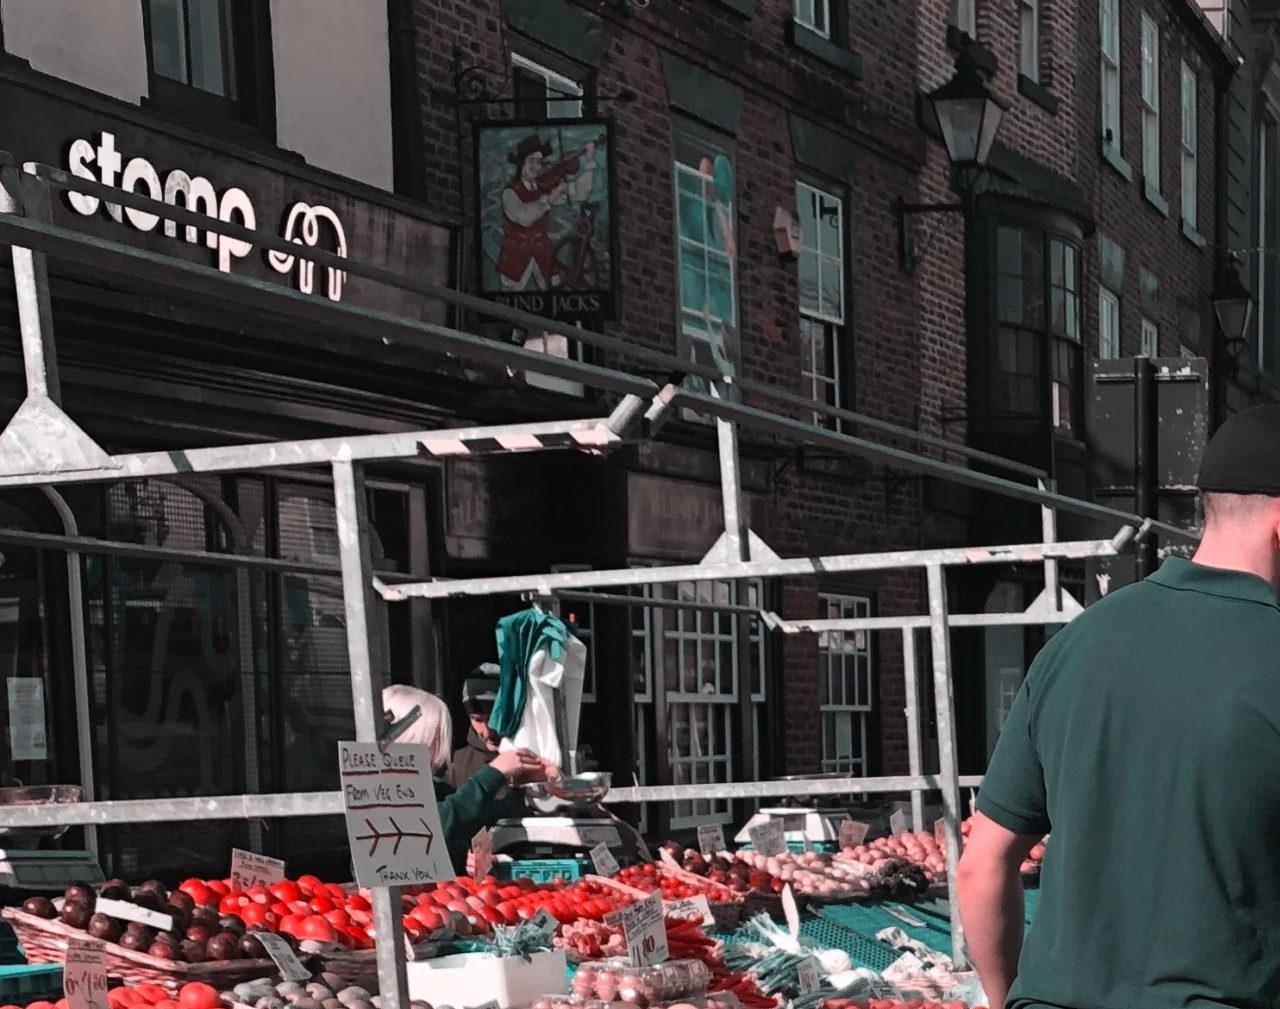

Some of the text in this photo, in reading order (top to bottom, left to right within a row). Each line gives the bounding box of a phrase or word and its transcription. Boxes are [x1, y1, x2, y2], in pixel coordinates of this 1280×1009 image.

[67, 131, 256, 273] stomp
[551, 294, 600, 317] JACKS
[342, 747, 416, 769] PLEASE QUEUE
[373, 783, 392, 802] VEG
[396, 784, 416, 800] END
[375, 864, 410, 883] THANK
